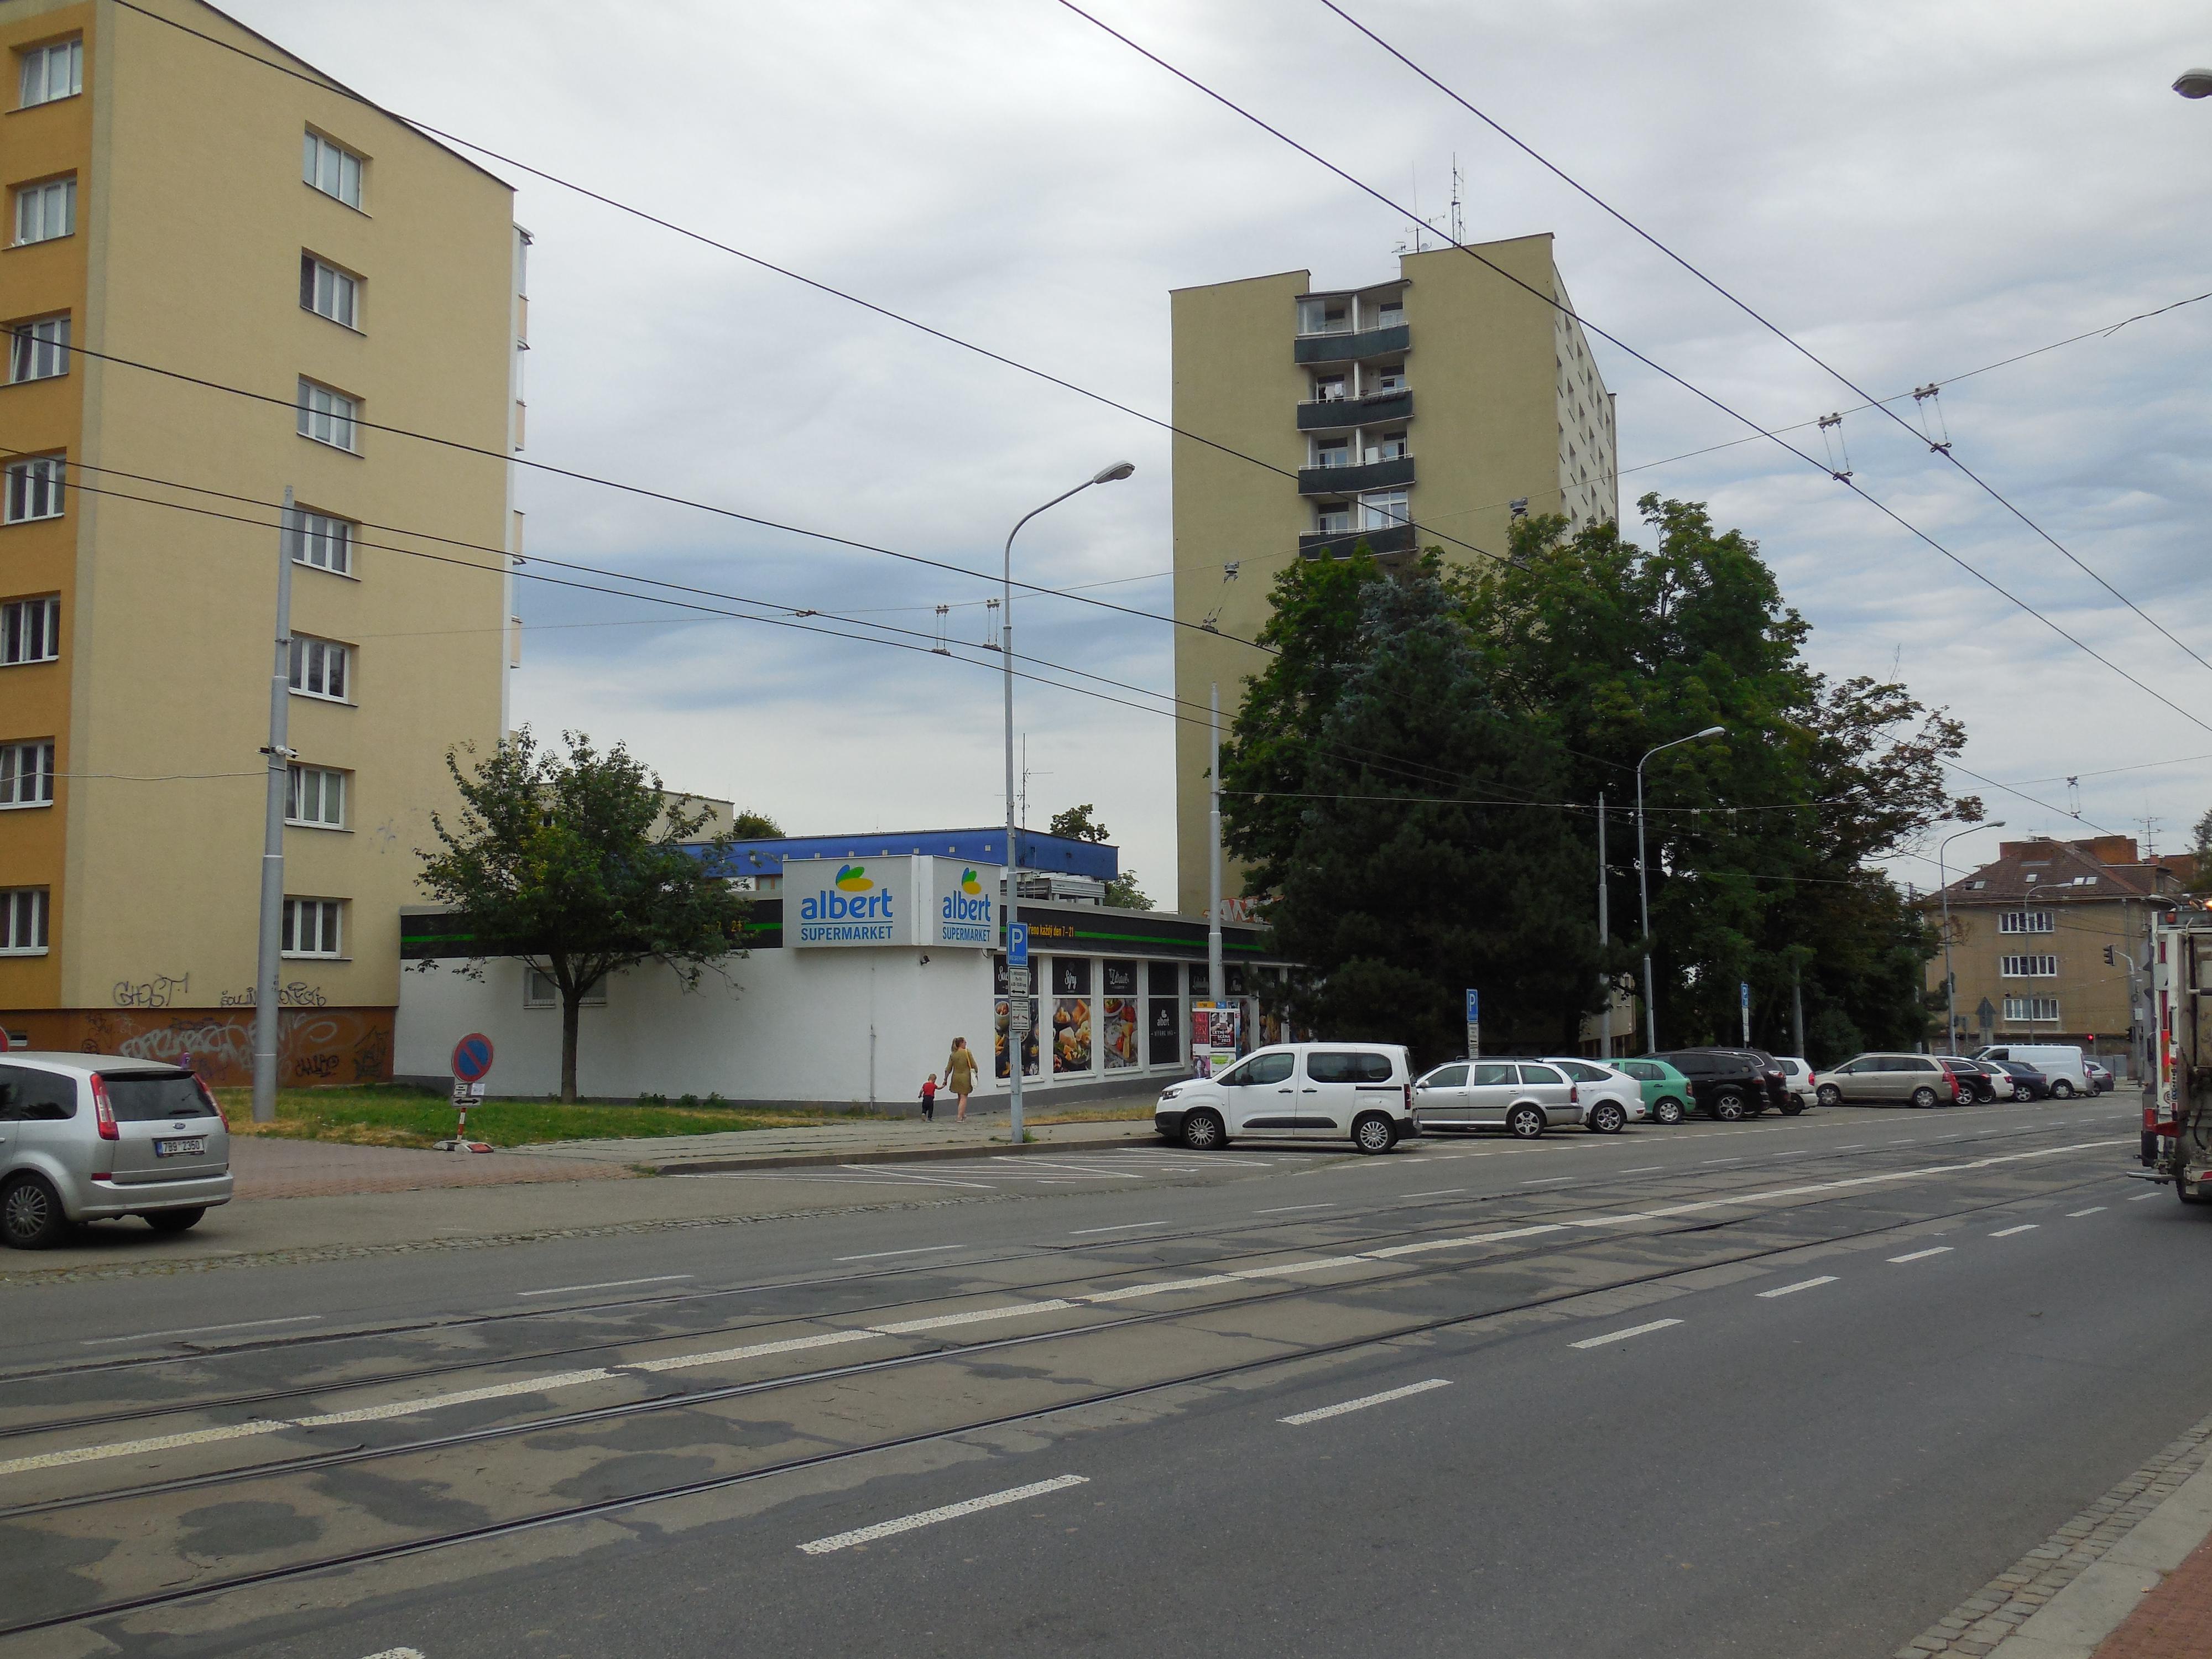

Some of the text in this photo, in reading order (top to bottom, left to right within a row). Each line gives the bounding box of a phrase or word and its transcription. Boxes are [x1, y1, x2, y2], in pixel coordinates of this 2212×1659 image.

[801, 888, 893, 920] albert
[943, 890, 991, 922] albert
[801, 926, 893, 941] SUPERMARKET
[943, 927, 990, 942] SUPERMARKET
